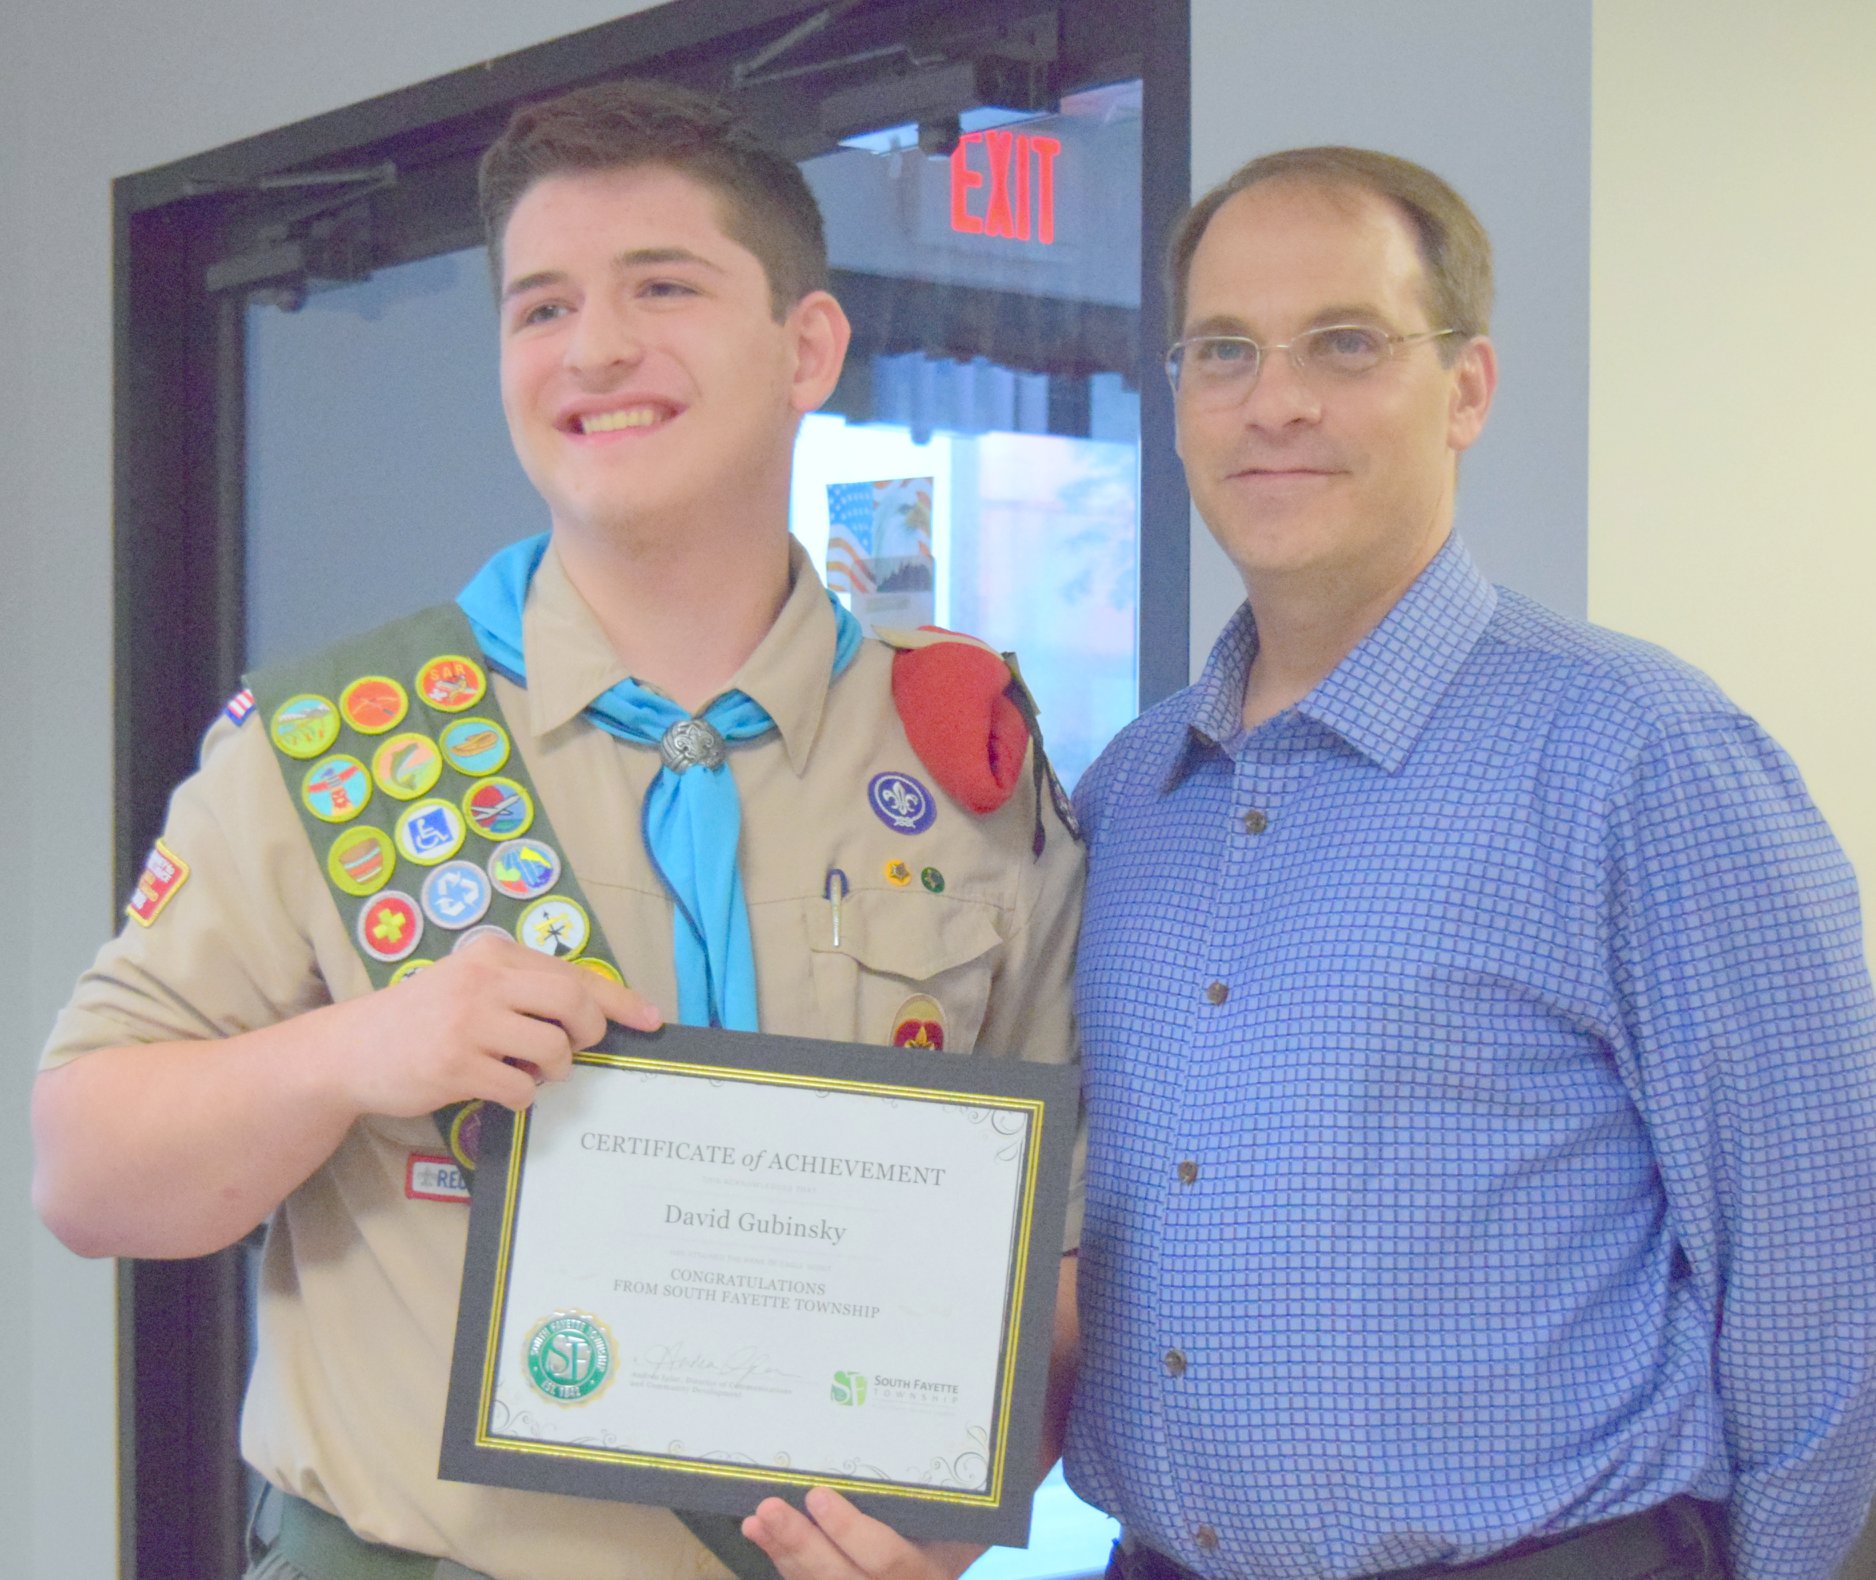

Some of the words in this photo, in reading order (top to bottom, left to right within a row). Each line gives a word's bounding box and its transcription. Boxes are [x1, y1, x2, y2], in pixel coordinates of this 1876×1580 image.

[951, 130, 1061, 244] EXIT
[580, 1131, 736, 1166] CERTIFICATE
[741, 1149, 767, 1172] of
[768, 1151, 946, 1187] ACHIEVEMENT
[665, 1204, 730, 1230] David
[738, 1212, 847, 1246] Gubinsky
[613, 1278, 658, 1296] FROM
[663, 1285, 716, 1303] SOUTH
[722, 1291, 790, 1310] FAYETTE
[795, 1298, 880, 1319] TOWNSHIP
[670, 1267, 826, 1296] CONGRATULATIONS
[874, 1388, 959, 1405] TOWNSHIP
[914, 1379, 959, 1395] FAYETTE
